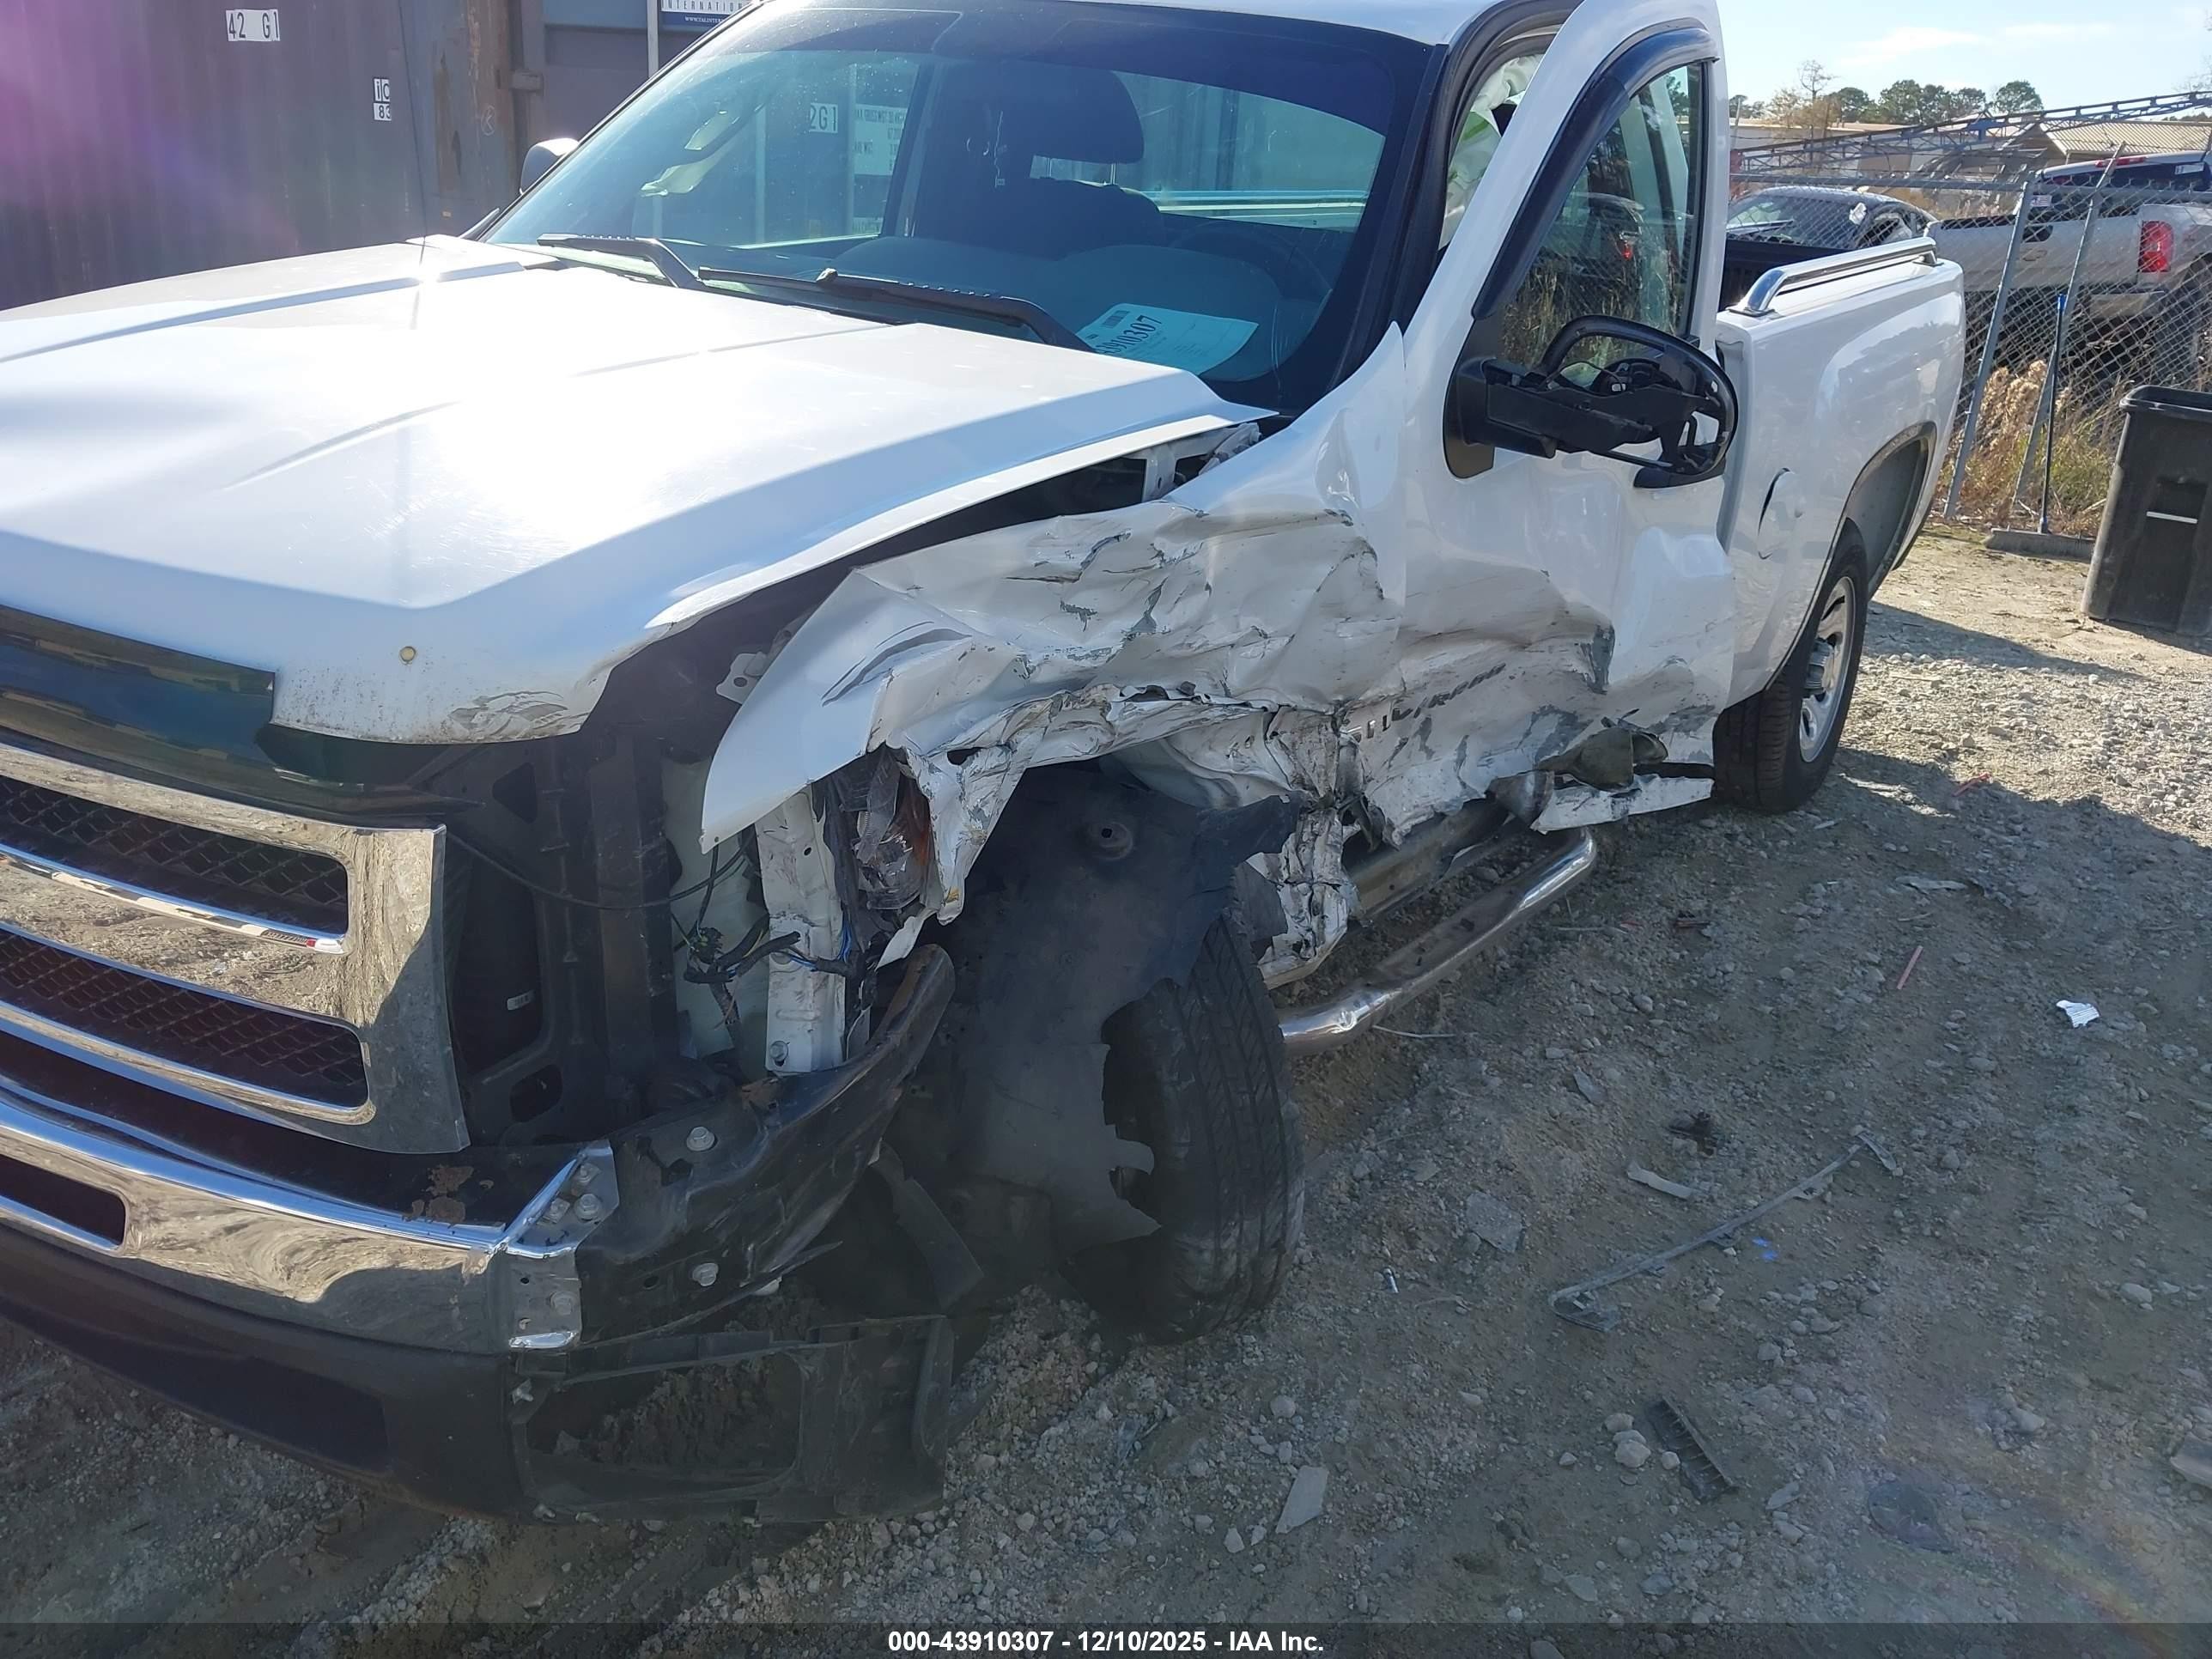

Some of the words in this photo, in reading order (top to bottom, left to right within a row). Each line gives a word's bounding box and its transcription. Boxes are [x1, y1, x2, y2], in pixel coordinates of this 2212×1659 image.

[228, 12, 246, 40] 42
[262, 11, 279, 40] G1
[810, 105, 837, 131] 2G1
[1095, 314, 1163, 355] 3910307
